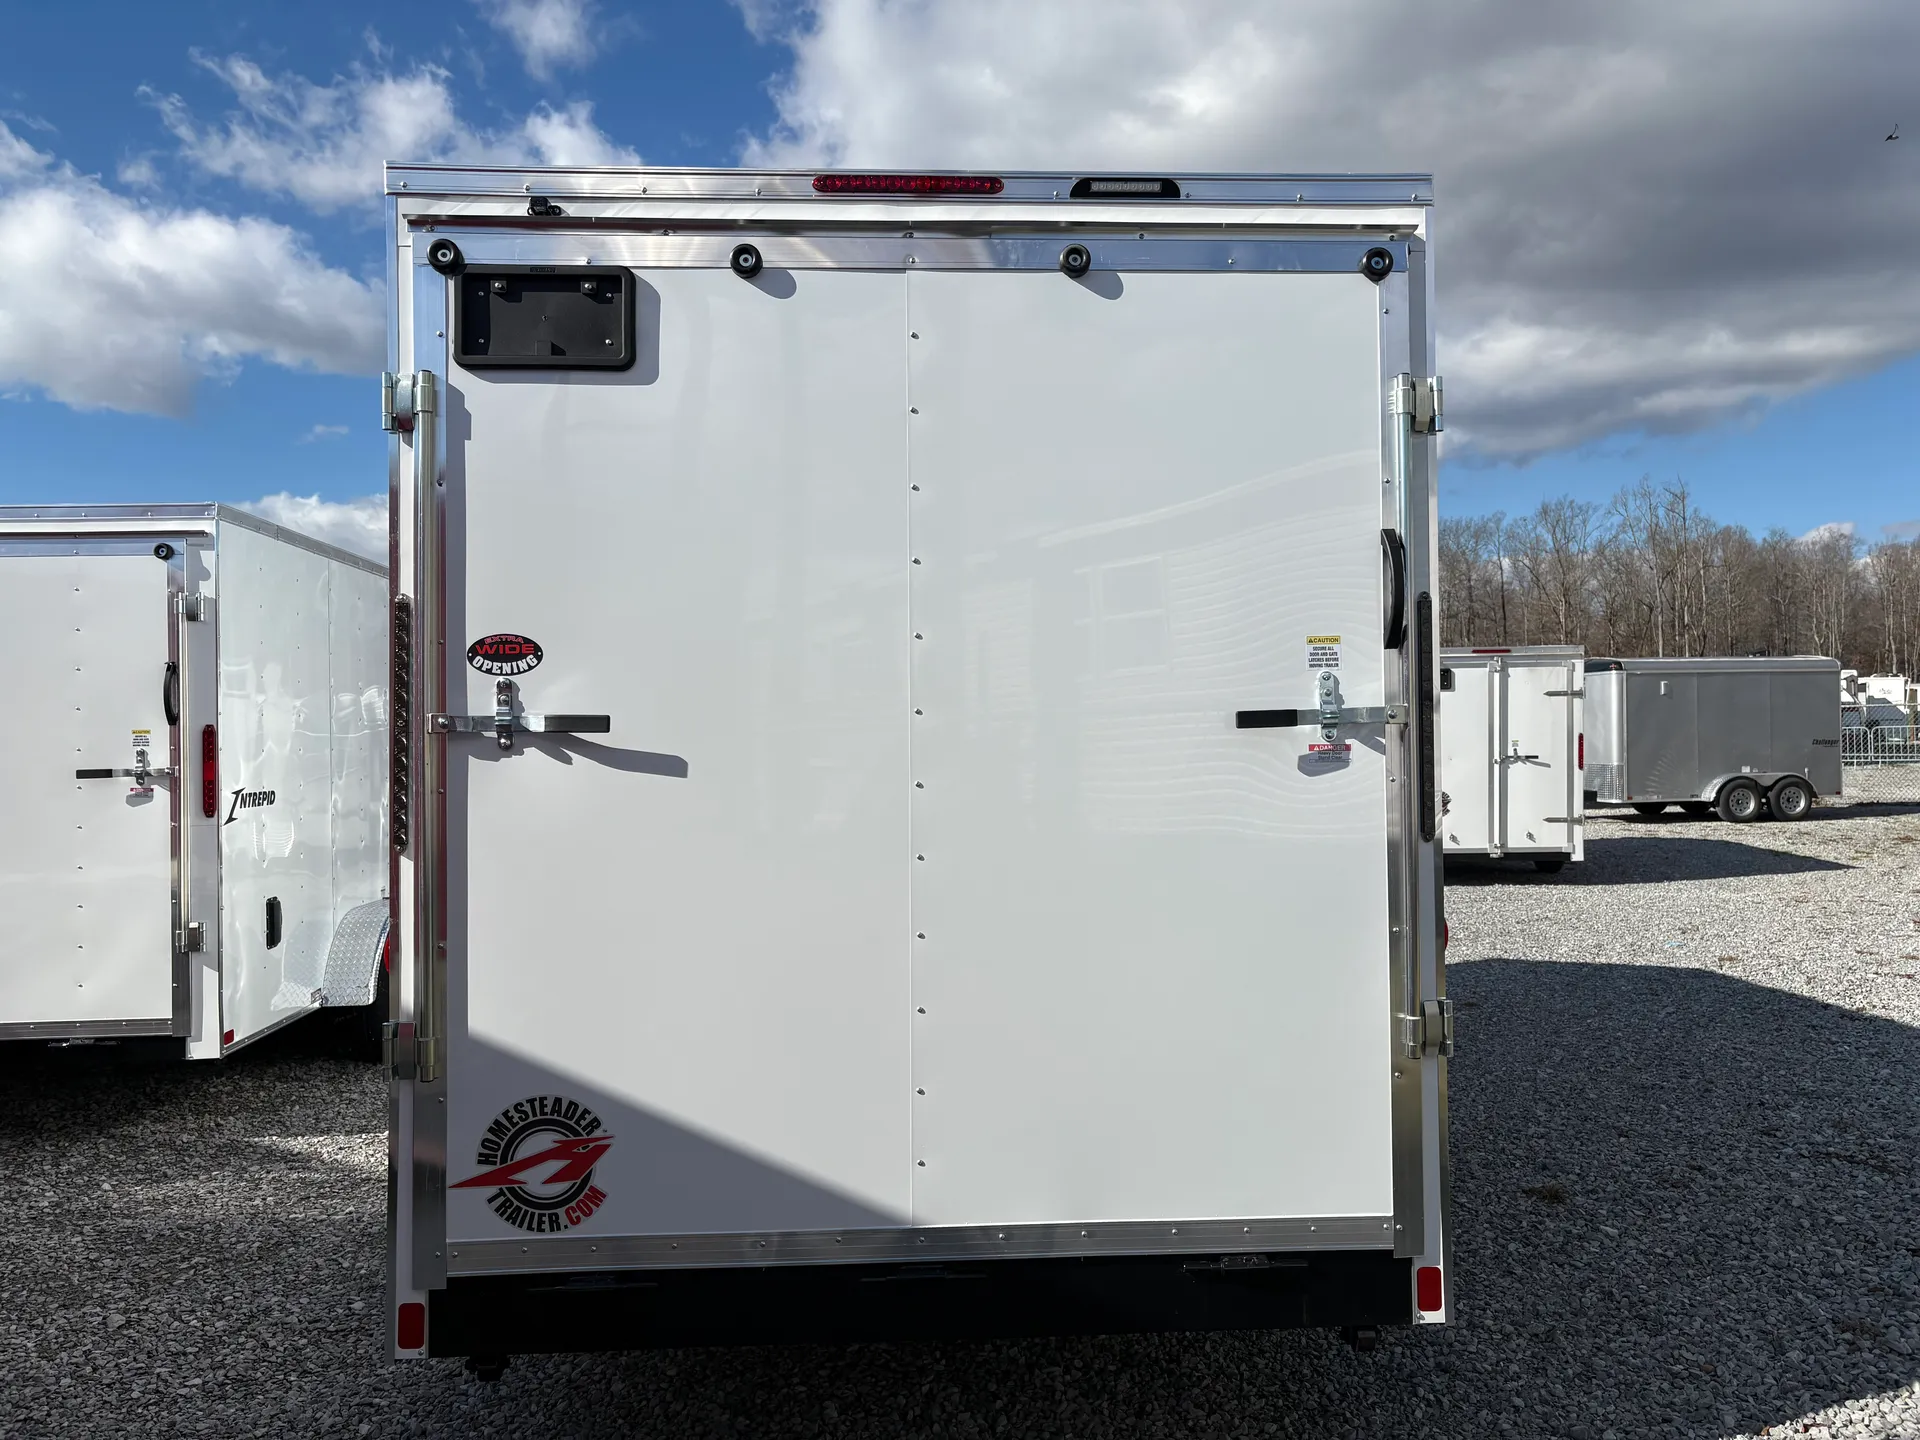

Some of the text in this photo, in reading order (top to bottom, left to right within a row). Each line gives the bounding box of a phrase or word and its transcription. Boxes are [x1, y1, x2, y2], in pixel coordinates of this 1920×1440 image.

[472, 654, 538, 674] OPENING
[475, 644, 534, 654] WIDE
[223, 787, 276, 827] INTREPID
[476, 1096, 602, 1166] HOMESTEADER
